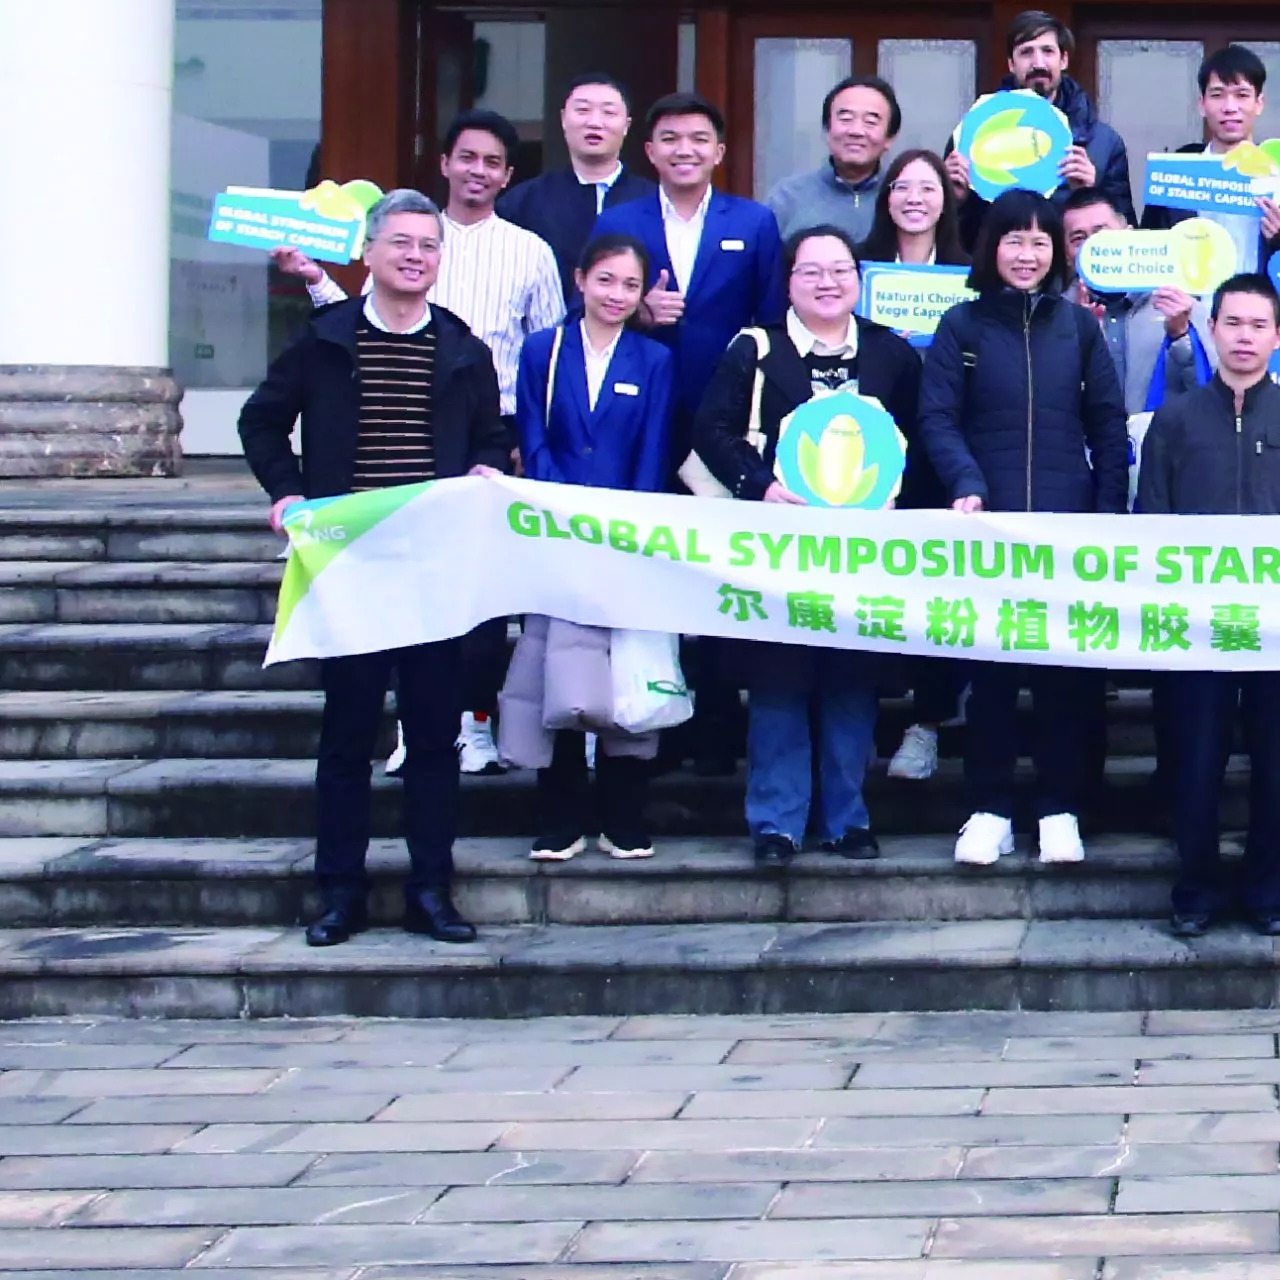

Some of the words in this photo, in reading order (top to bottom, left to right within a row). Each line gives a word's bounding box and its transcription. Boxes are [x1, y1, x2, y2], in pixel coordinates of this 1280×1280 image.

[1150, 171, 1196, 187] GLOBAL
[1149, 184, 1166, 197] OF
[1166, 186, 1211, 202] STARCH
[218, 206, 269, 224] GLOBAL
[214, 220, 235, 234] OF
[236, 222, 286, 244] STARCH
[287, 232, 347, 254] CAPSULE
[1090, 246, 1123, 257] New
[1128, 245, 1168, 257] Trend
[1090, 263, 1123, 274] New
[1128, 261, 1175, 274] Choice
[876, 291, 924, 303] Natural
[928, 292, 970, 304] Choice
[876, 305, 909, 318] Vege
[912, 306, 945, 320] Caps
[506, 500, 711, 564] GLOBAL
[728, 530, 1055, 580] SYMPOSIUM
[1072, 544, 1140, 583] OF
